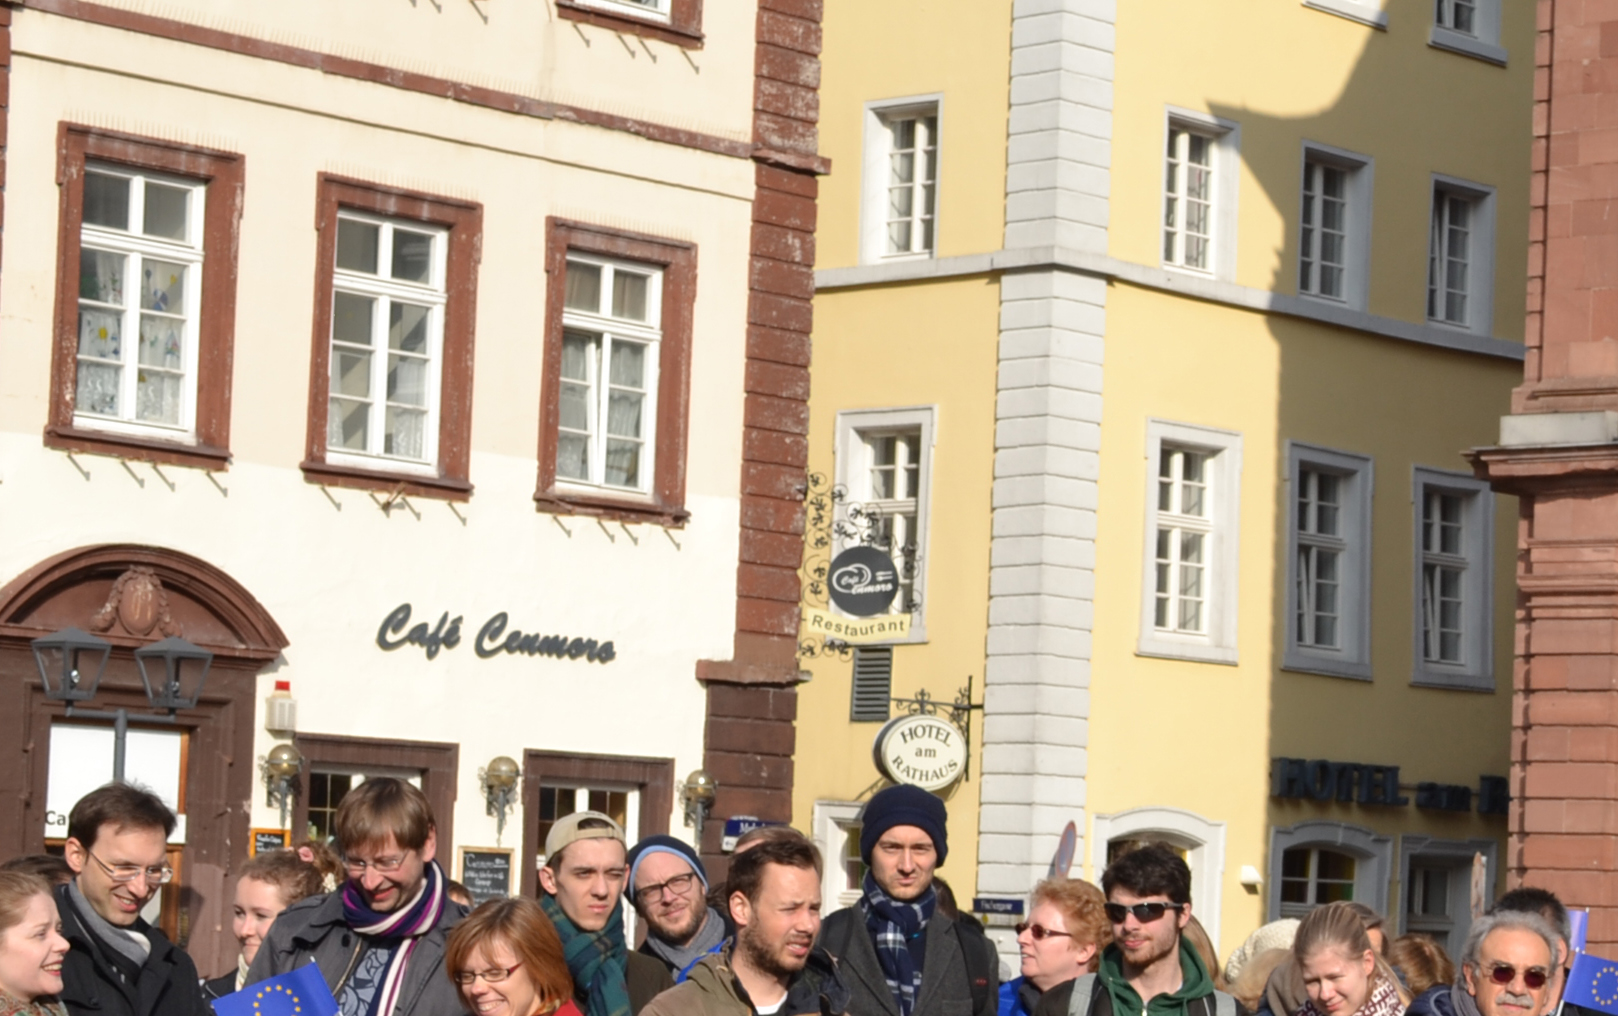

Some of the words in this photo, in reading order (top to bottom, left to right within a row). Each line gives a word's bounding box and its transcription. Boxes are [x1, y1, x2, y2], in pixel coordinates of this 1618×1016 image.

[376, 603, 463, 661] Café
[475, 612, 616, 664] Cenmoro
[812, 614, 905, 637] Restaurant
[900, 724, 952, 747] HOTEL
[914, 747, 937, 758] am
[891, 755, 958, 781] RATHAUS
[1271, 757, 1409, 806] HOTEL
[1416, 781, 1471, 811] am
